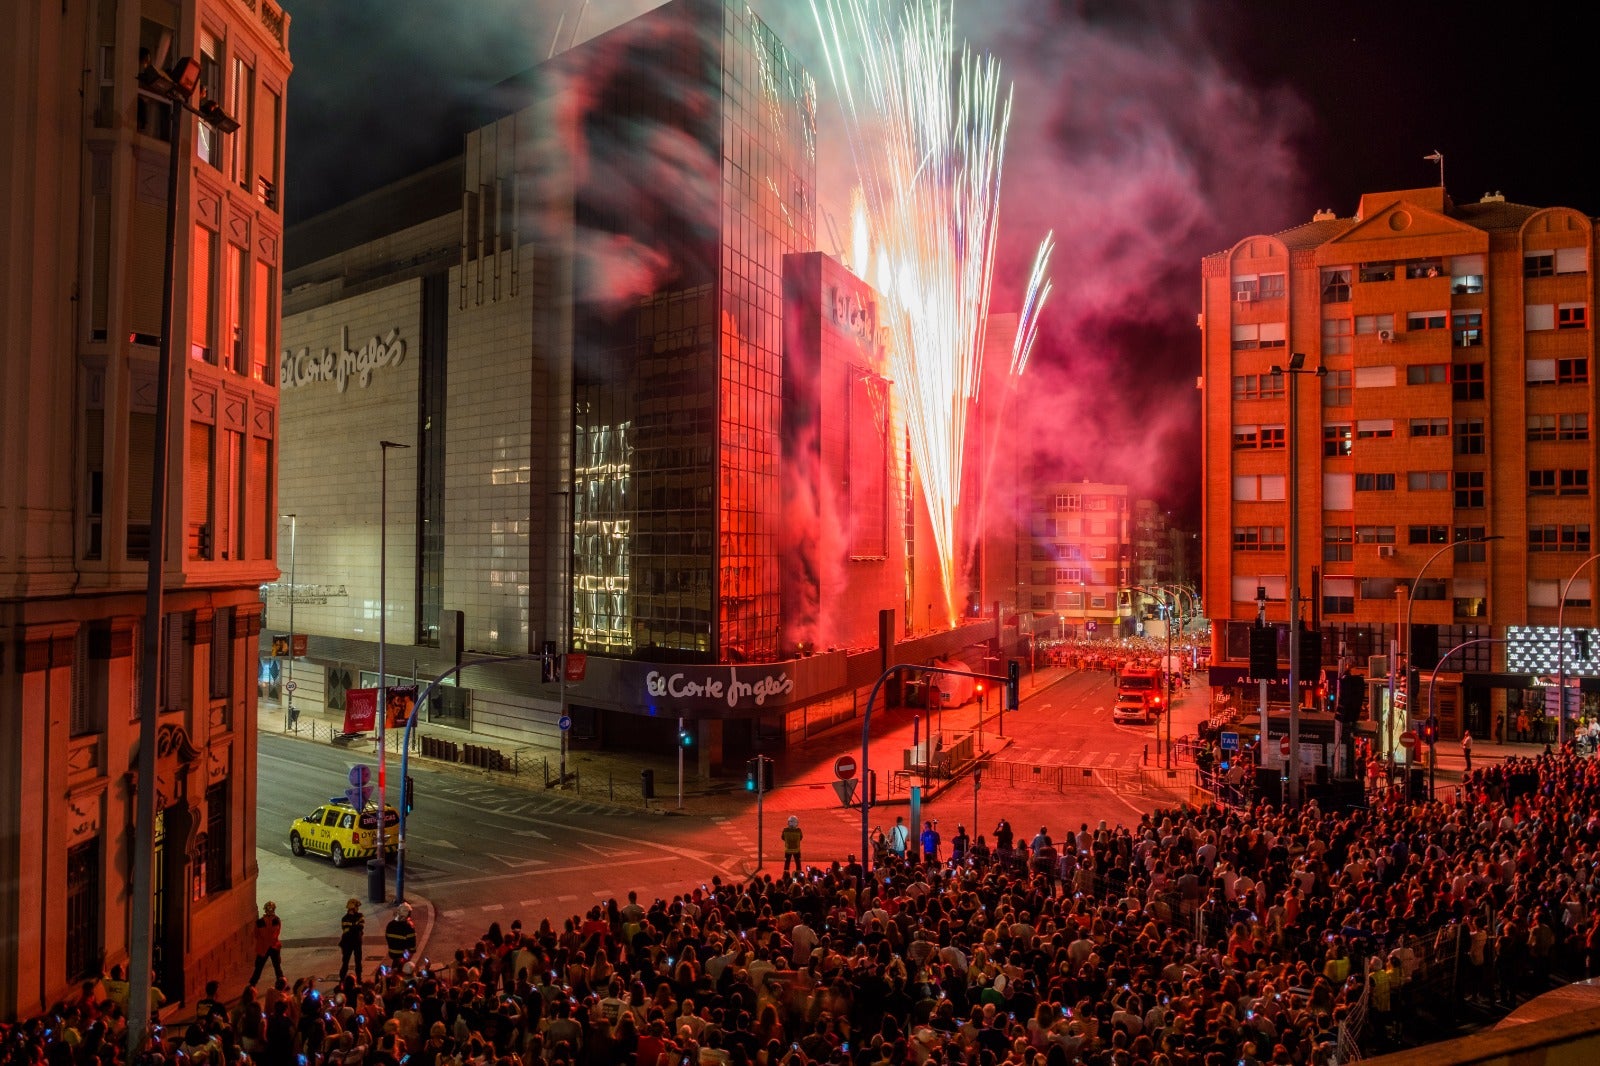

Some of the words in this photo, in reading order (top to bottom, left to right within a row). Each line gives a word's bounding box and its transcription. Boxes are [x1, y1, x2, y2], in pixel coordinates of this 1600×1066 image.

[294, 346, 337, 387] Corte
[337, 325, 407, 393] Inglés
[646, 671, 667, 697] El
[667, 673, 723, 698] Corte
[727, 667, 794, 707] Inglés
[1237, 676, 1277, 685] AEDS
[1222, 737, 1237, 745] TAXI
